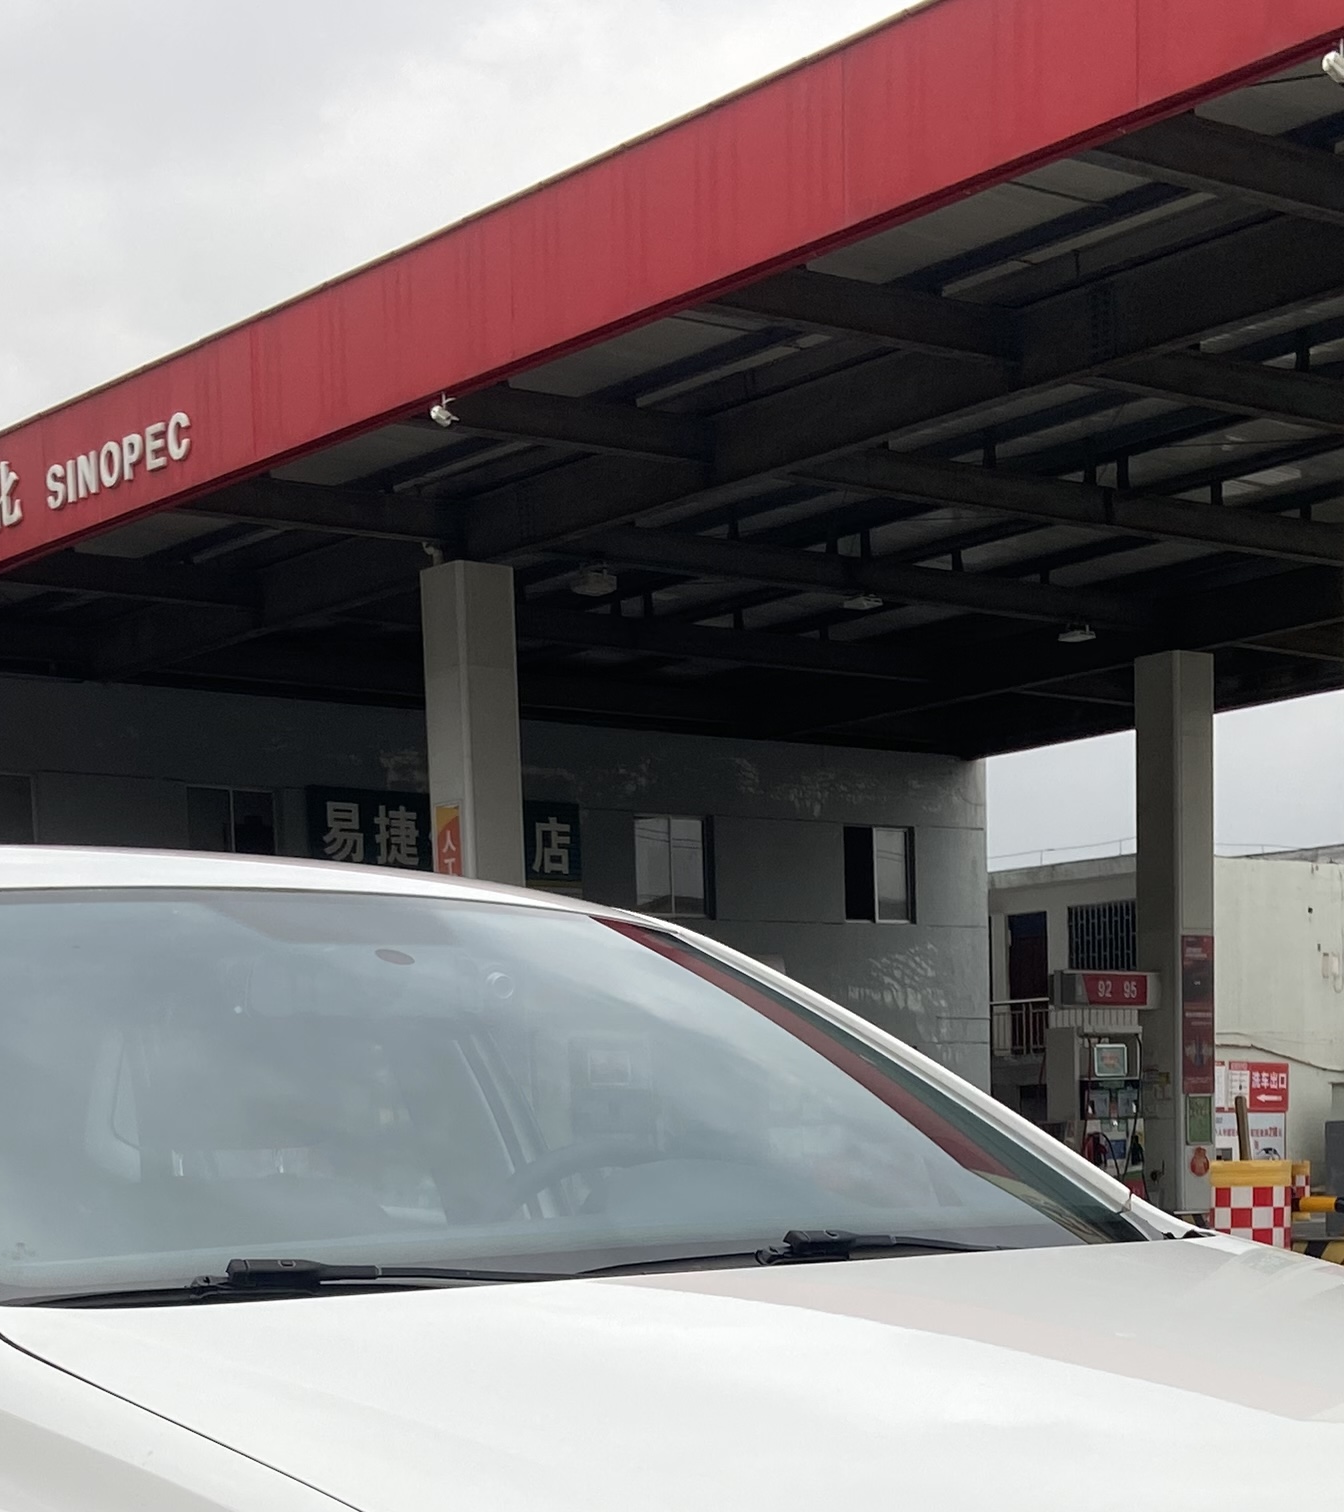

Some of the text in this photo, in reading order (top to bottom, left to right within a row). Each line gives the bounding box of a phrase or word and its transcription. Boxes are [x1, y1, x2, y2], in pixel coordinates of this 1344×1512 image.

[46, 411, 191, 510] SINOPEC
[322, 801, 572, 875] 易捷 店
[1098, 980, 1137, 999] 92 95
